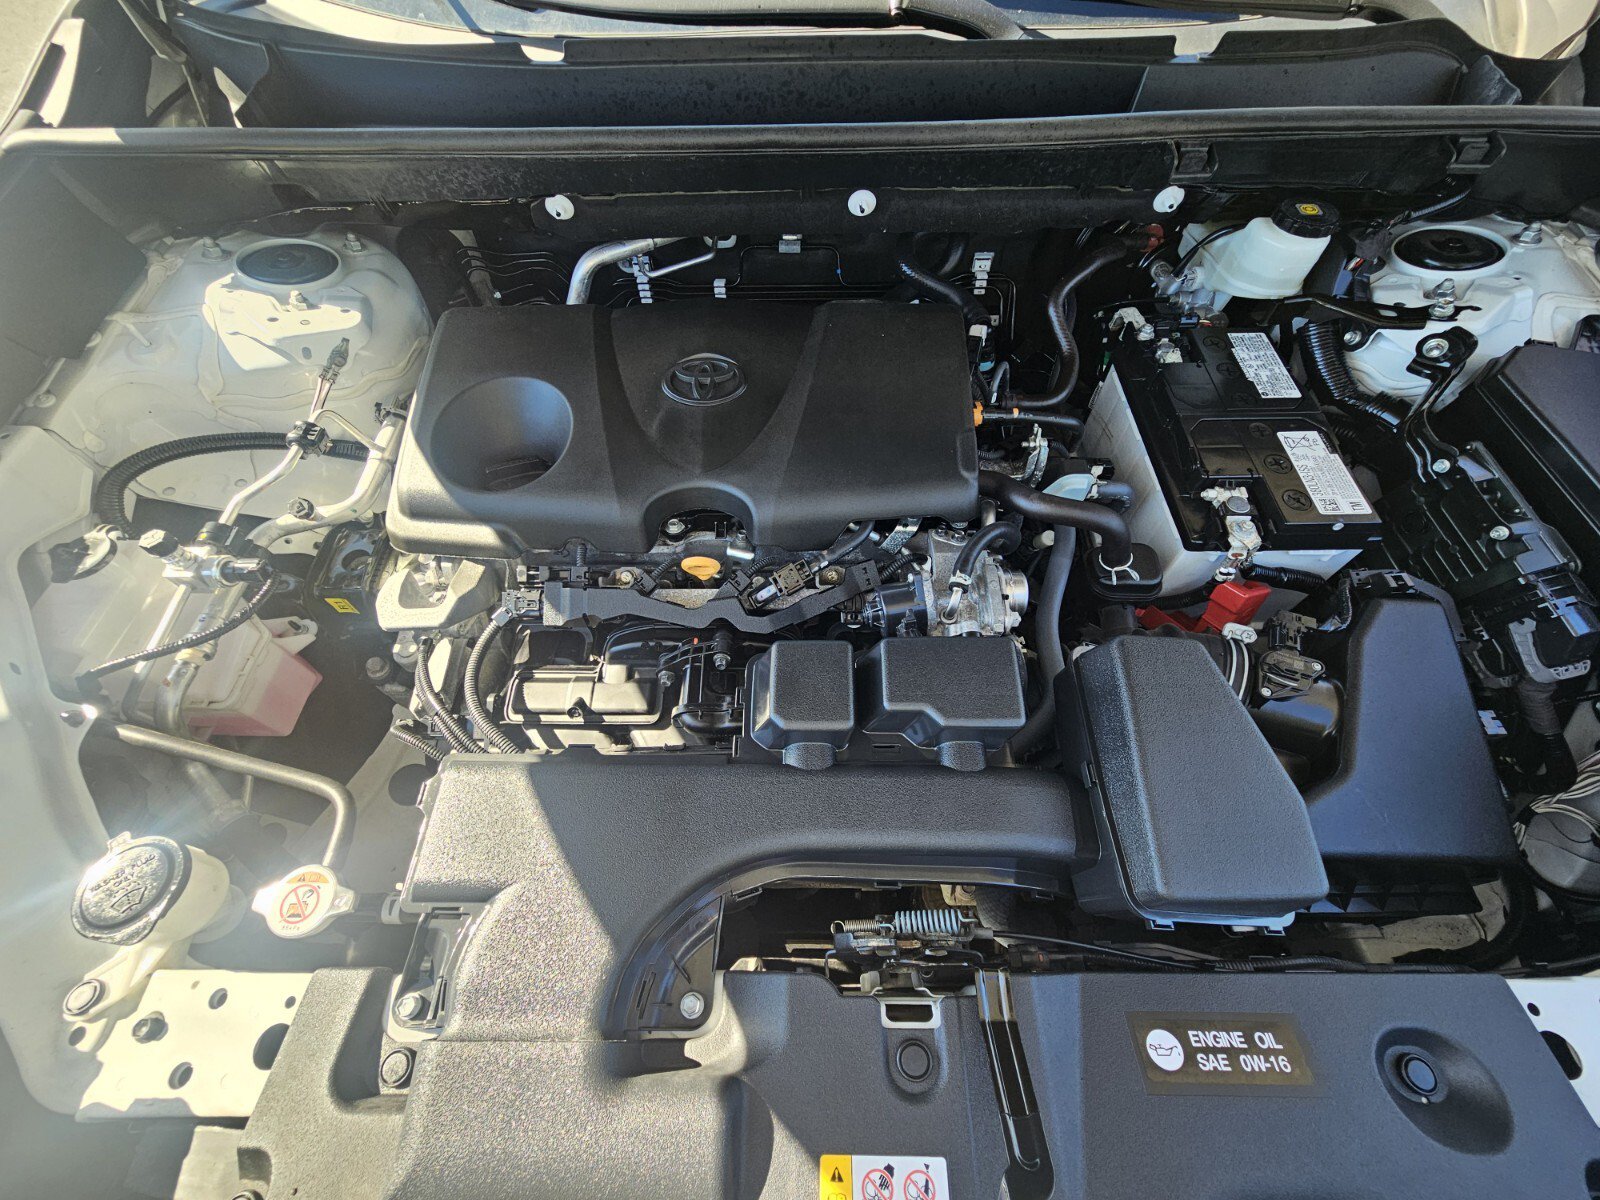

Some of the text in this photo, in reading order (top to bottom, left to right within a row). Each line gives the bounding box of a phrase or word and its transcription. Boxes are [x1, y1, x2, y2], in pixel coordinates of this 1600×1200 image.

[1187, 1030, 1284, 1050] ENGINE OIL
[1196, 1053, 1292, 1074] SAE 0W-16
